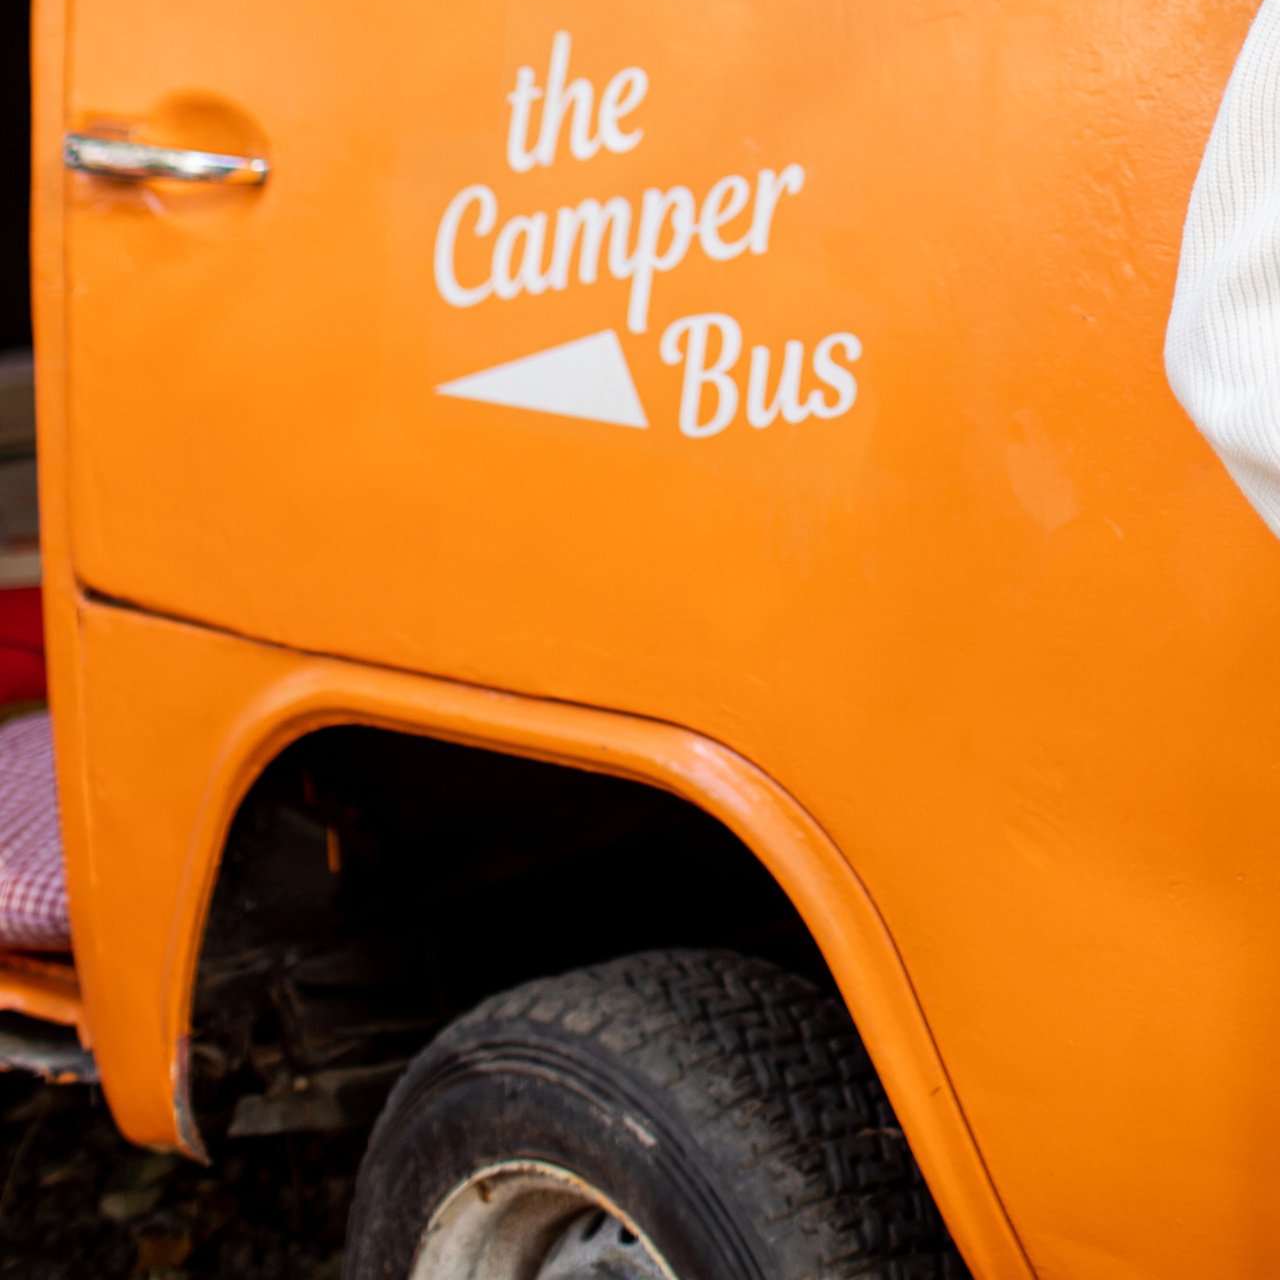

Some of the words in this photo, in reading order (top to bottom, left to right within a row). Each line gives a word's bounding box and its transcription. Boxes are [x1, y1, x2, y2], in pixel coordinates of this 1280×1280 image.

[507, 30, 649, 173] the
[434, 163, 805, 334] Camper
[660, 312, 862, 438] Bus
